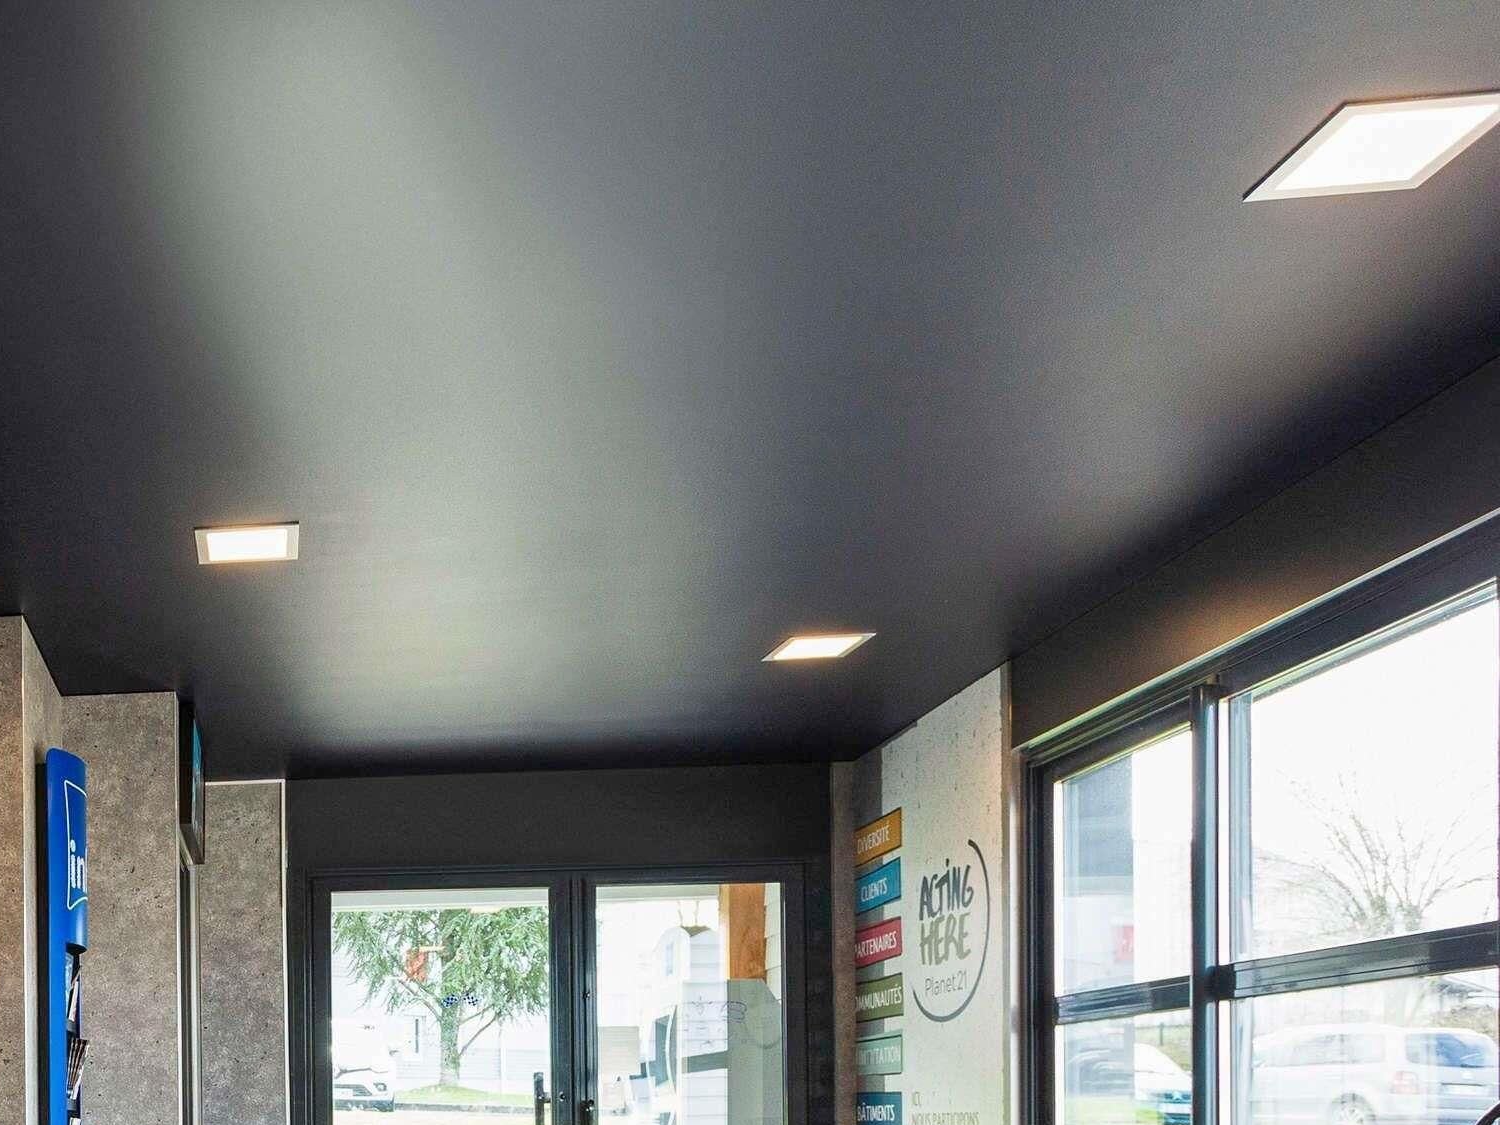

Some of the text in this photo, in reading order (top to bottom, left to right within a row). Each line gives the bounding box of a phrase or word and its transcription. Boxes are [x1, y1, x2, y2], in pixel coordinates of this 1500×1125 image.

[861, 877, 888, 902] CLIENTS
[919, 858, 975, 921] ACTING
[919, 911, 972, 966] HERE
[857, 1102, 895, 1121] BÂTIMENTS
